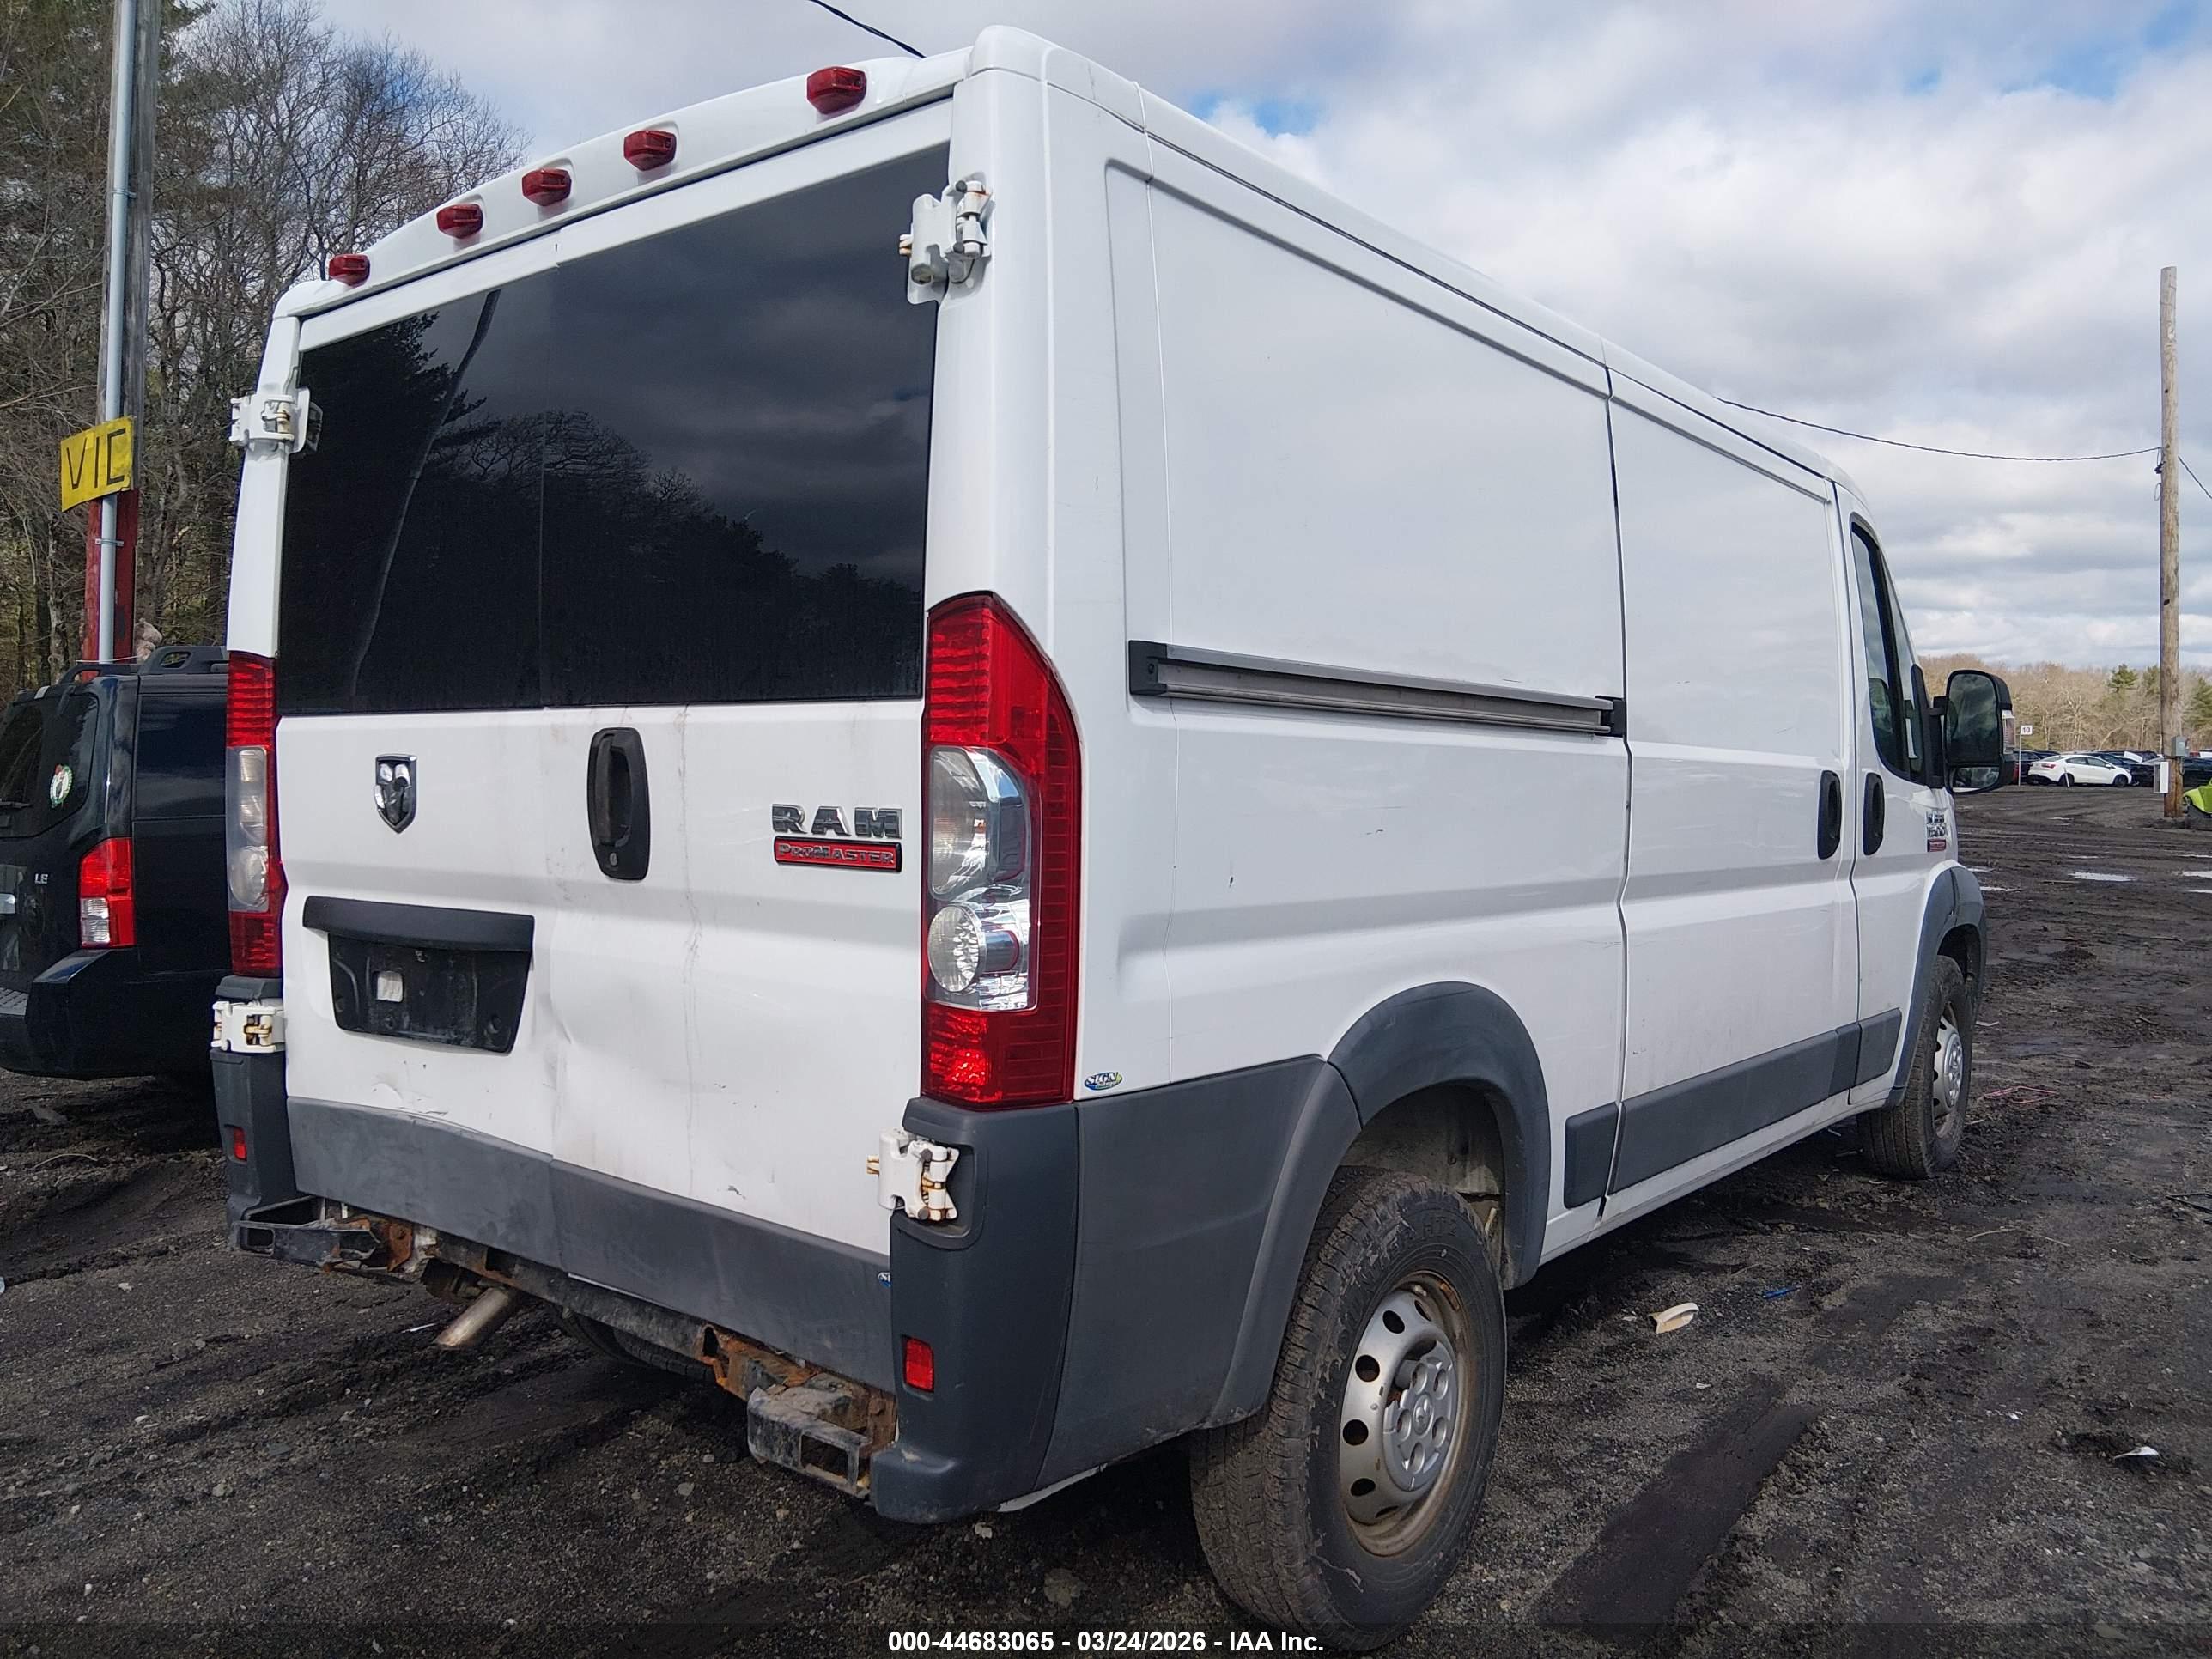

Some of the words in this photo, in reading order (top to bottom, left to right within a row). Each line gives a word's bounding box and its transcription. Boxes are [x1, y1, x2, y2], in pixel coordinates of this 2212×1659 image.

[66, 428, 126, 489] VIC
[772, 804, 902, 839] RAM
[34, 873, 48, 884] LE
